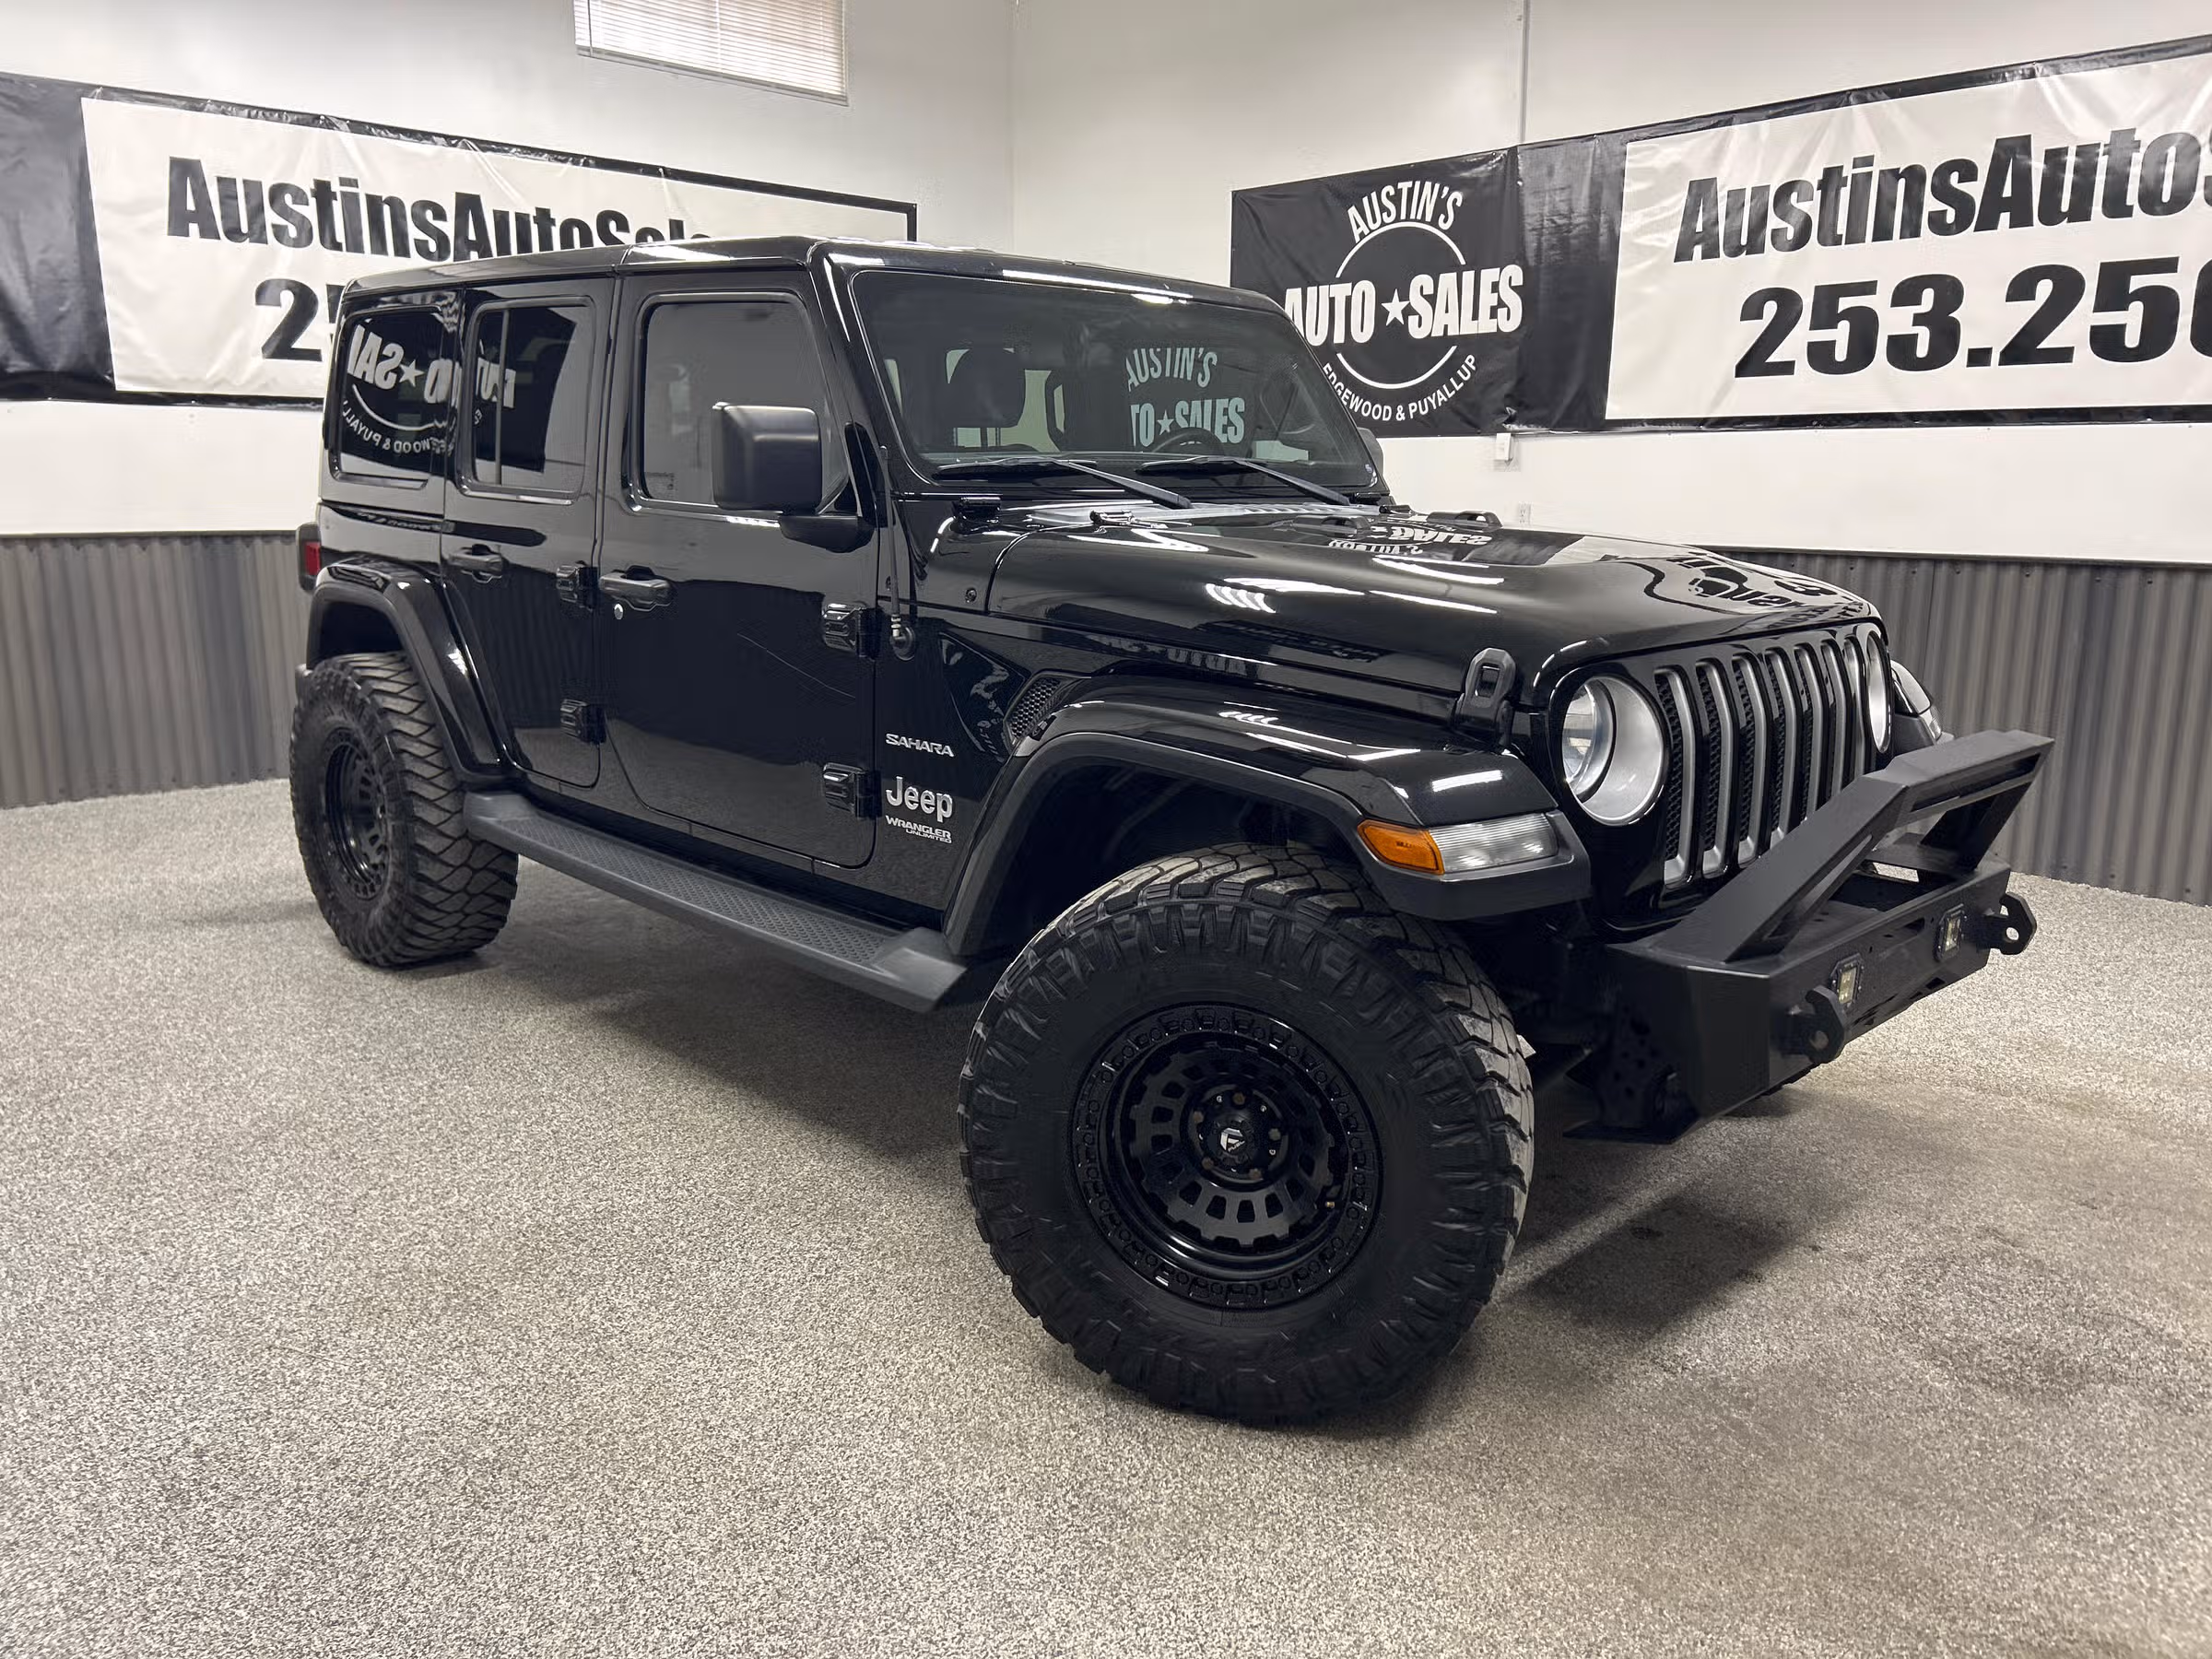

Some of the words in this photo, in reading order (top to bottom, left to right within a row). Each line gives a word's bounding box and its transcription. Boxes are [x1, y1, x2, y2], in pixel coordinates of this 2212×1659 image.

[1347, 181, 1464, 243] AUSTIN'S
[1674, 128, 2212, 264] AustinsAuto
[253, 278, 345, 362] 2
[1284, 279, 1376, 346] AUTO
[1408, 264, 1524, 339] SALES
[1734, 256, 2212, 378] 253.25
[1395, 405, 1406, 421] &
[1408, 354, 1476, 419] PUYALLUP
[885, 733, 955, 758] SAHARA
[885, 776, 953, 823] Jeep
[885, 815, 952, 840] WRANGLER
[906, 829, 952, 844] UNLIMITED
